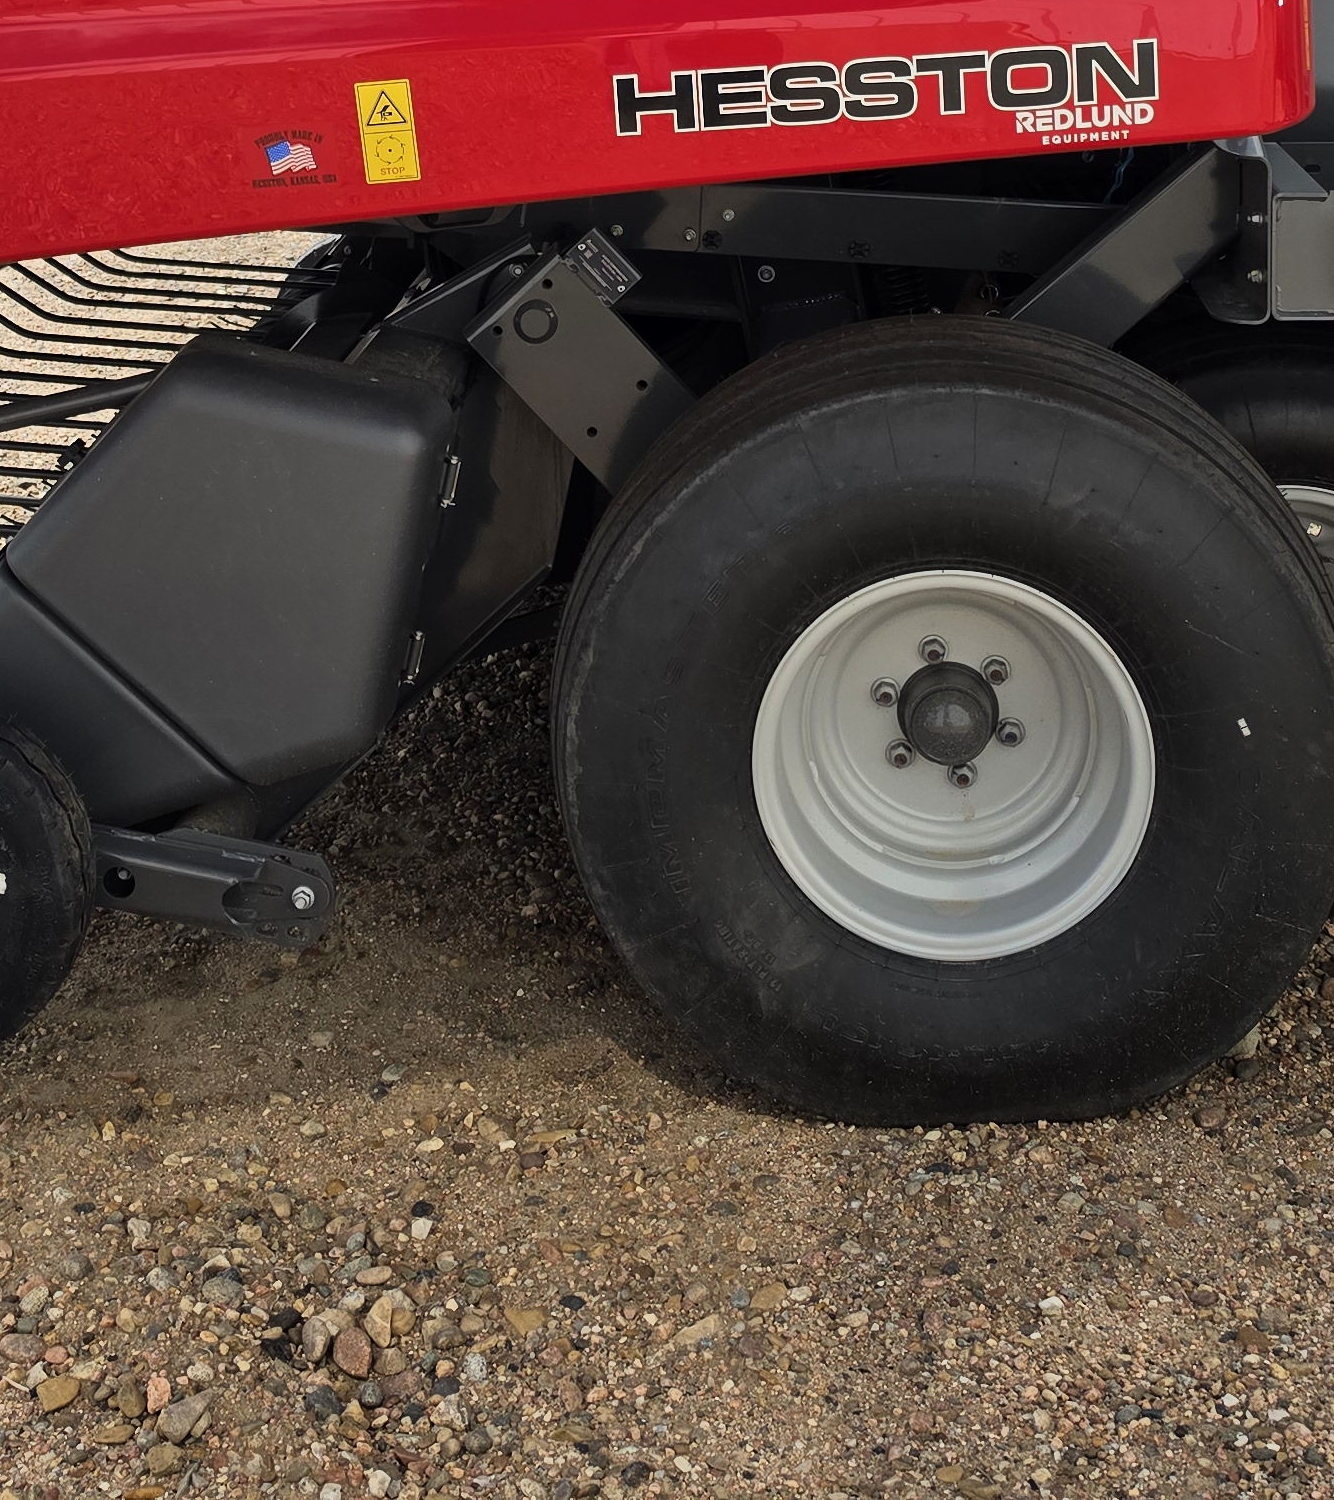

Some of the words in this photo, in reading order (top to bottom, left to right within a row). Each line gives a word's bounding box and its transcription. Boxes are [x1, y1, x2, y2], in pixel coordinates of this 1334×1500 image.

[613, 37, 1160, 137] HESSTON
[1016, 103, 1155, 133] REDLUND
[254, 130, 288, 149] PROUDLY
[291, 130, 313, 141] MADE
[1042, 129, 1130, 145] EQUIPMENT
[290, 174, 321, 185] KANSAS,
[322, 173, 337, 183] USA
[380, 166, 405, 176] STOP
